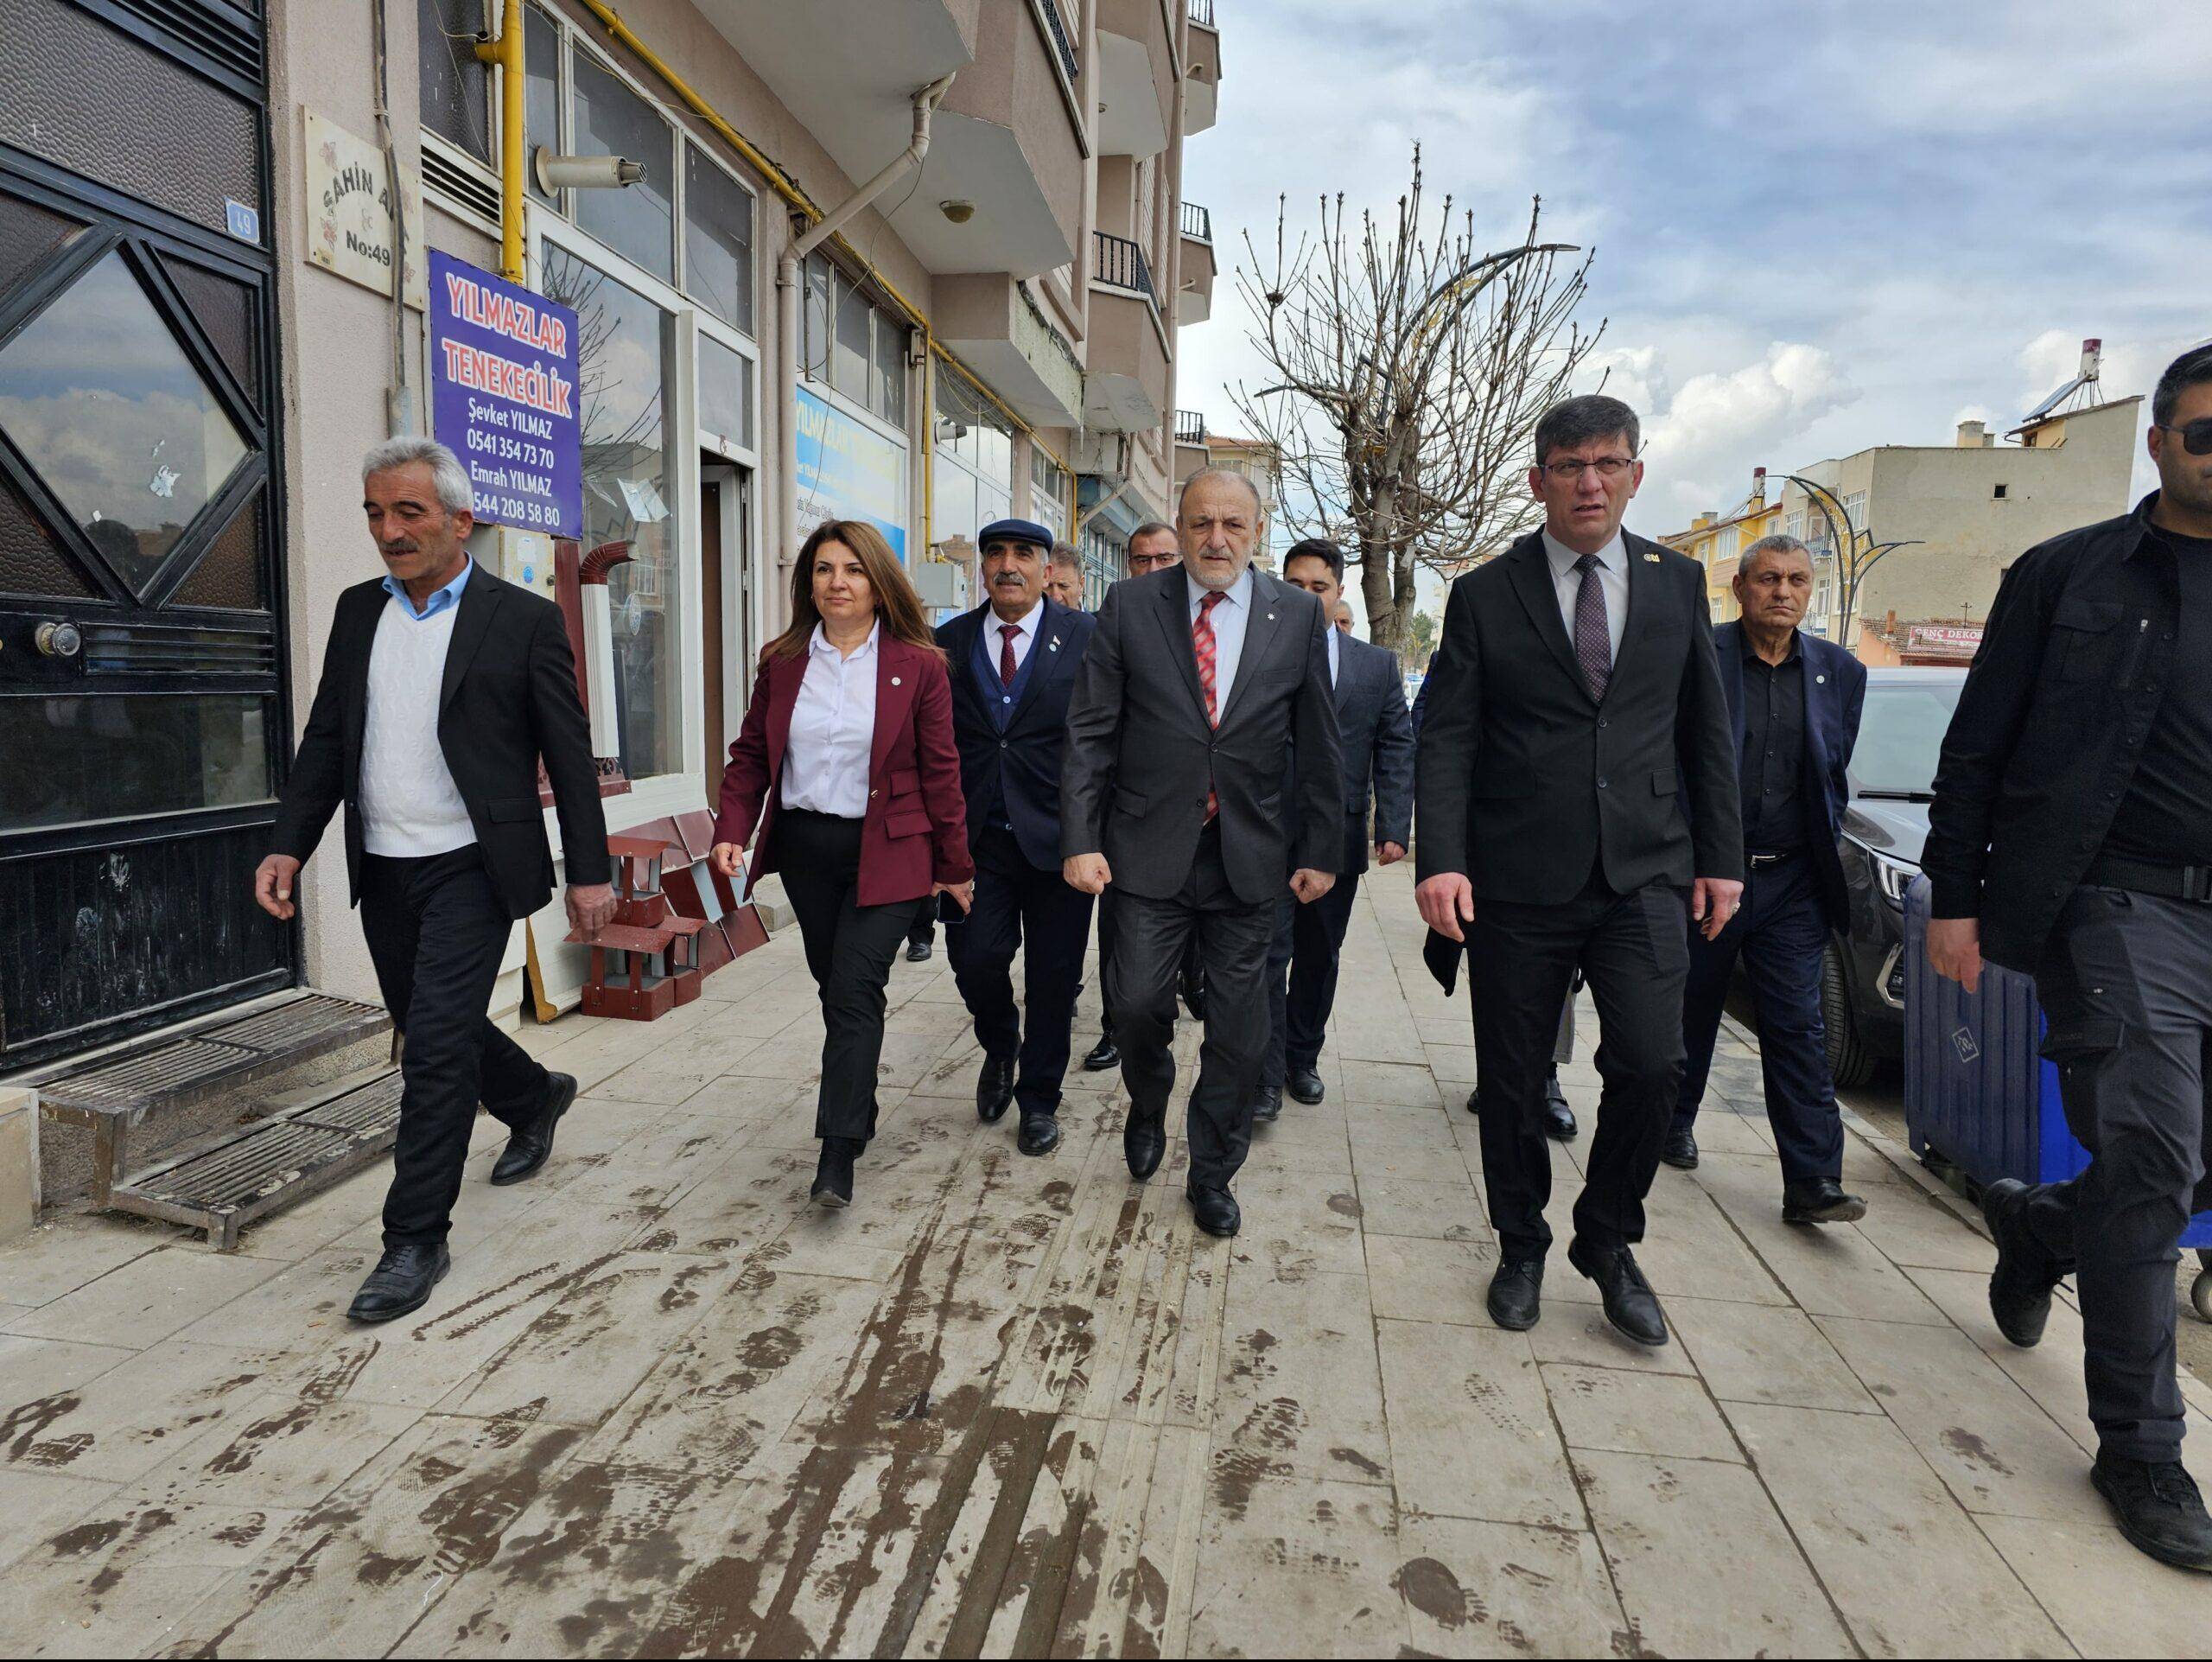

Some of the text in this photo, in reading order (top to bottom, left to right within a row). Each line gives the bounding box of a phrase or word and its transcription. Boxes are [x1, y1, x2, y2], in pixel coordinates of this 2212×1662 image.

[236, 211, 251, 235] 49
[346, 230, 391, 267] No:49
[446, 272, 567, 359] YILMAZLAR
[442, 337, 572, 419] TENEKECİLİK
[468, 397, 553, 440] Şevket YILMAZ
[467, 429, 555, 469] 0541 354 73 70
[471, 460, 552, 498] Emrah YILMAZ
[473, 491, 560, 527] 544 208 58 80
